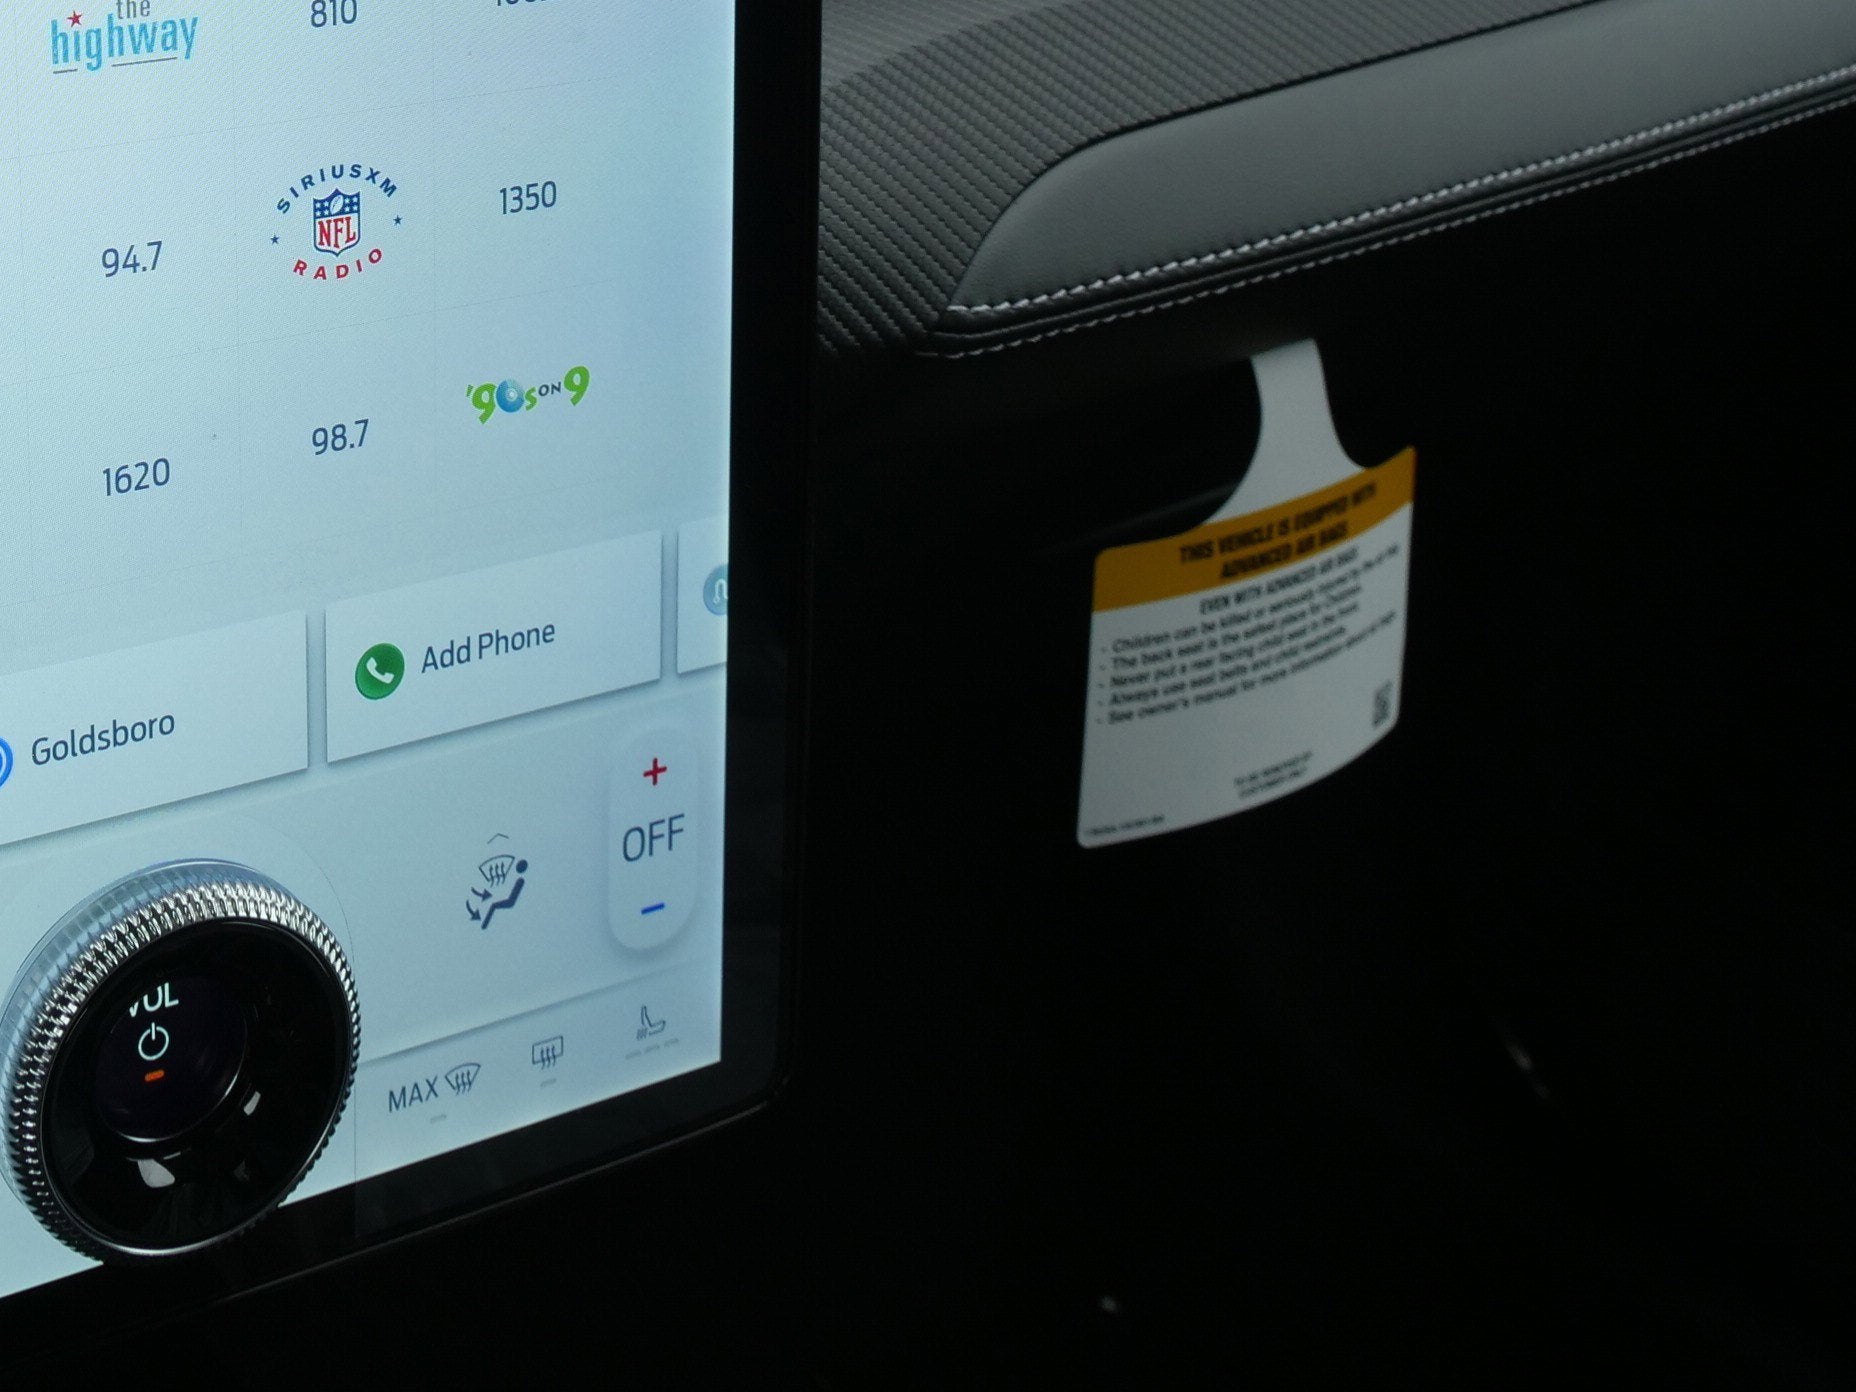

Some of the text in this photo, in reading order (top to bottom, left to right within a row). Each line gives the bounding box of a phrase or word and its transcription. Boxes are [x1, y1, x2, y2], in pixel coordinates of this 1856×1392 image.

[51, 10, 198, 71] highway
[277, 163, 397, 215] SIRIUSXM
[499, 180, 557, 216] 1350
[317, 215, 357, 249] NFL
[101, 240, 163, 277] 94.7
[293, 247, 382, 280] RADIO
[563, 366, 590, 406] 9
[311, 419, 369, 456] 98.7
[102, 457, 171, 497] 1620
[421, 618, 556, 675] Add Phone
[31, 710, 175, 766] Goldsboro
[622, 813, 685, 862] OFF
[388, 1075, 439, 1113] MAX
